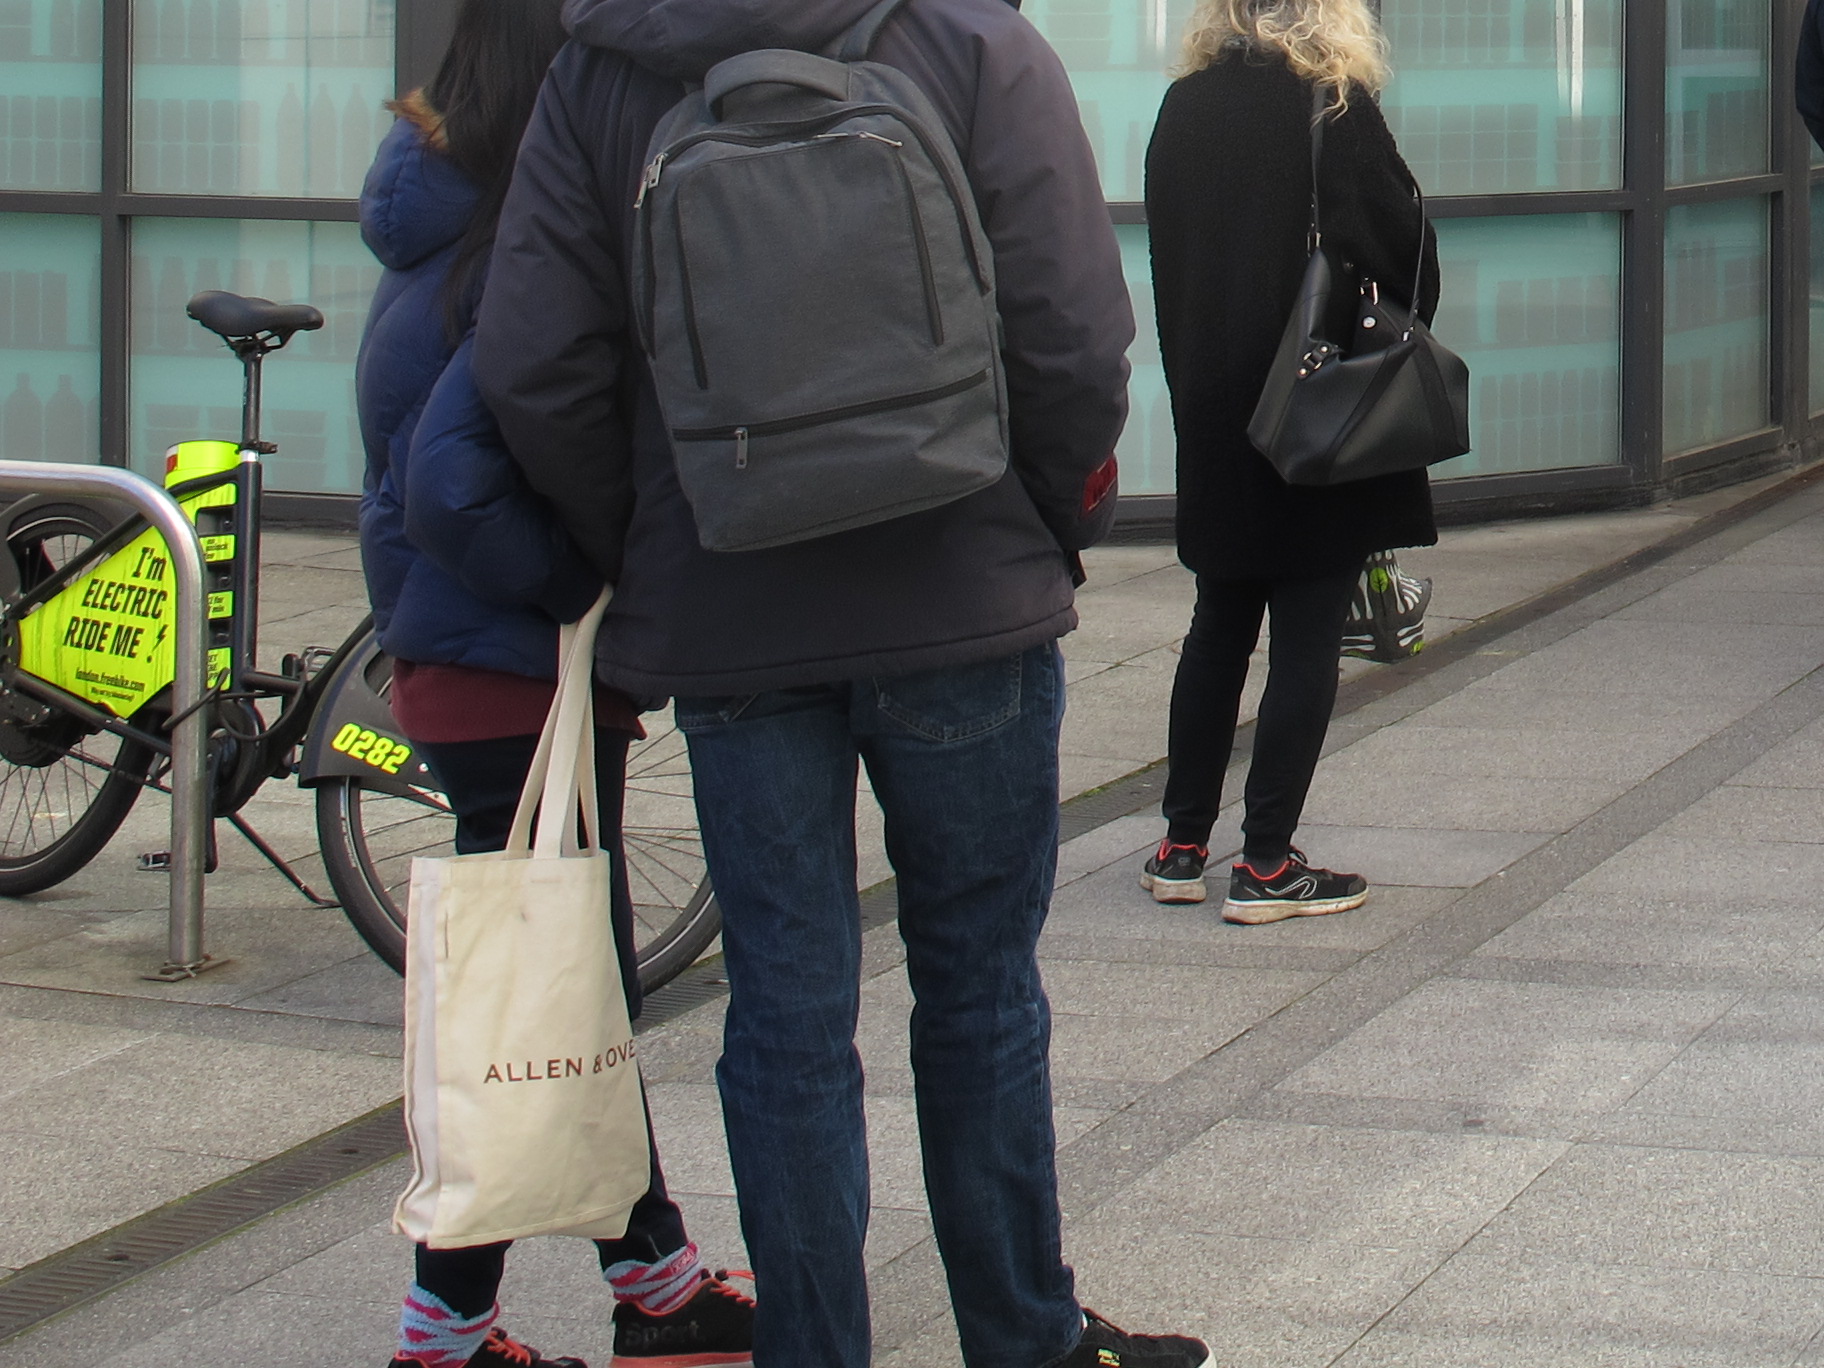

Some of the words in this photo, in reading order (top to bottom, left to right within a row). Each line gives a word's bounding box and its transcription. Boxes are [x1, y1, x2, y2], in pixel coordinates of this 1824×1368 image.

[132, 546, 167, 582] I'm
[81, 578, 168, 620] ELECTRIC
[62, 616, 113, 653] RIDE
[331, 721, 413, 775] 0282
[484, 1056, 583, 1084] ALLEN
